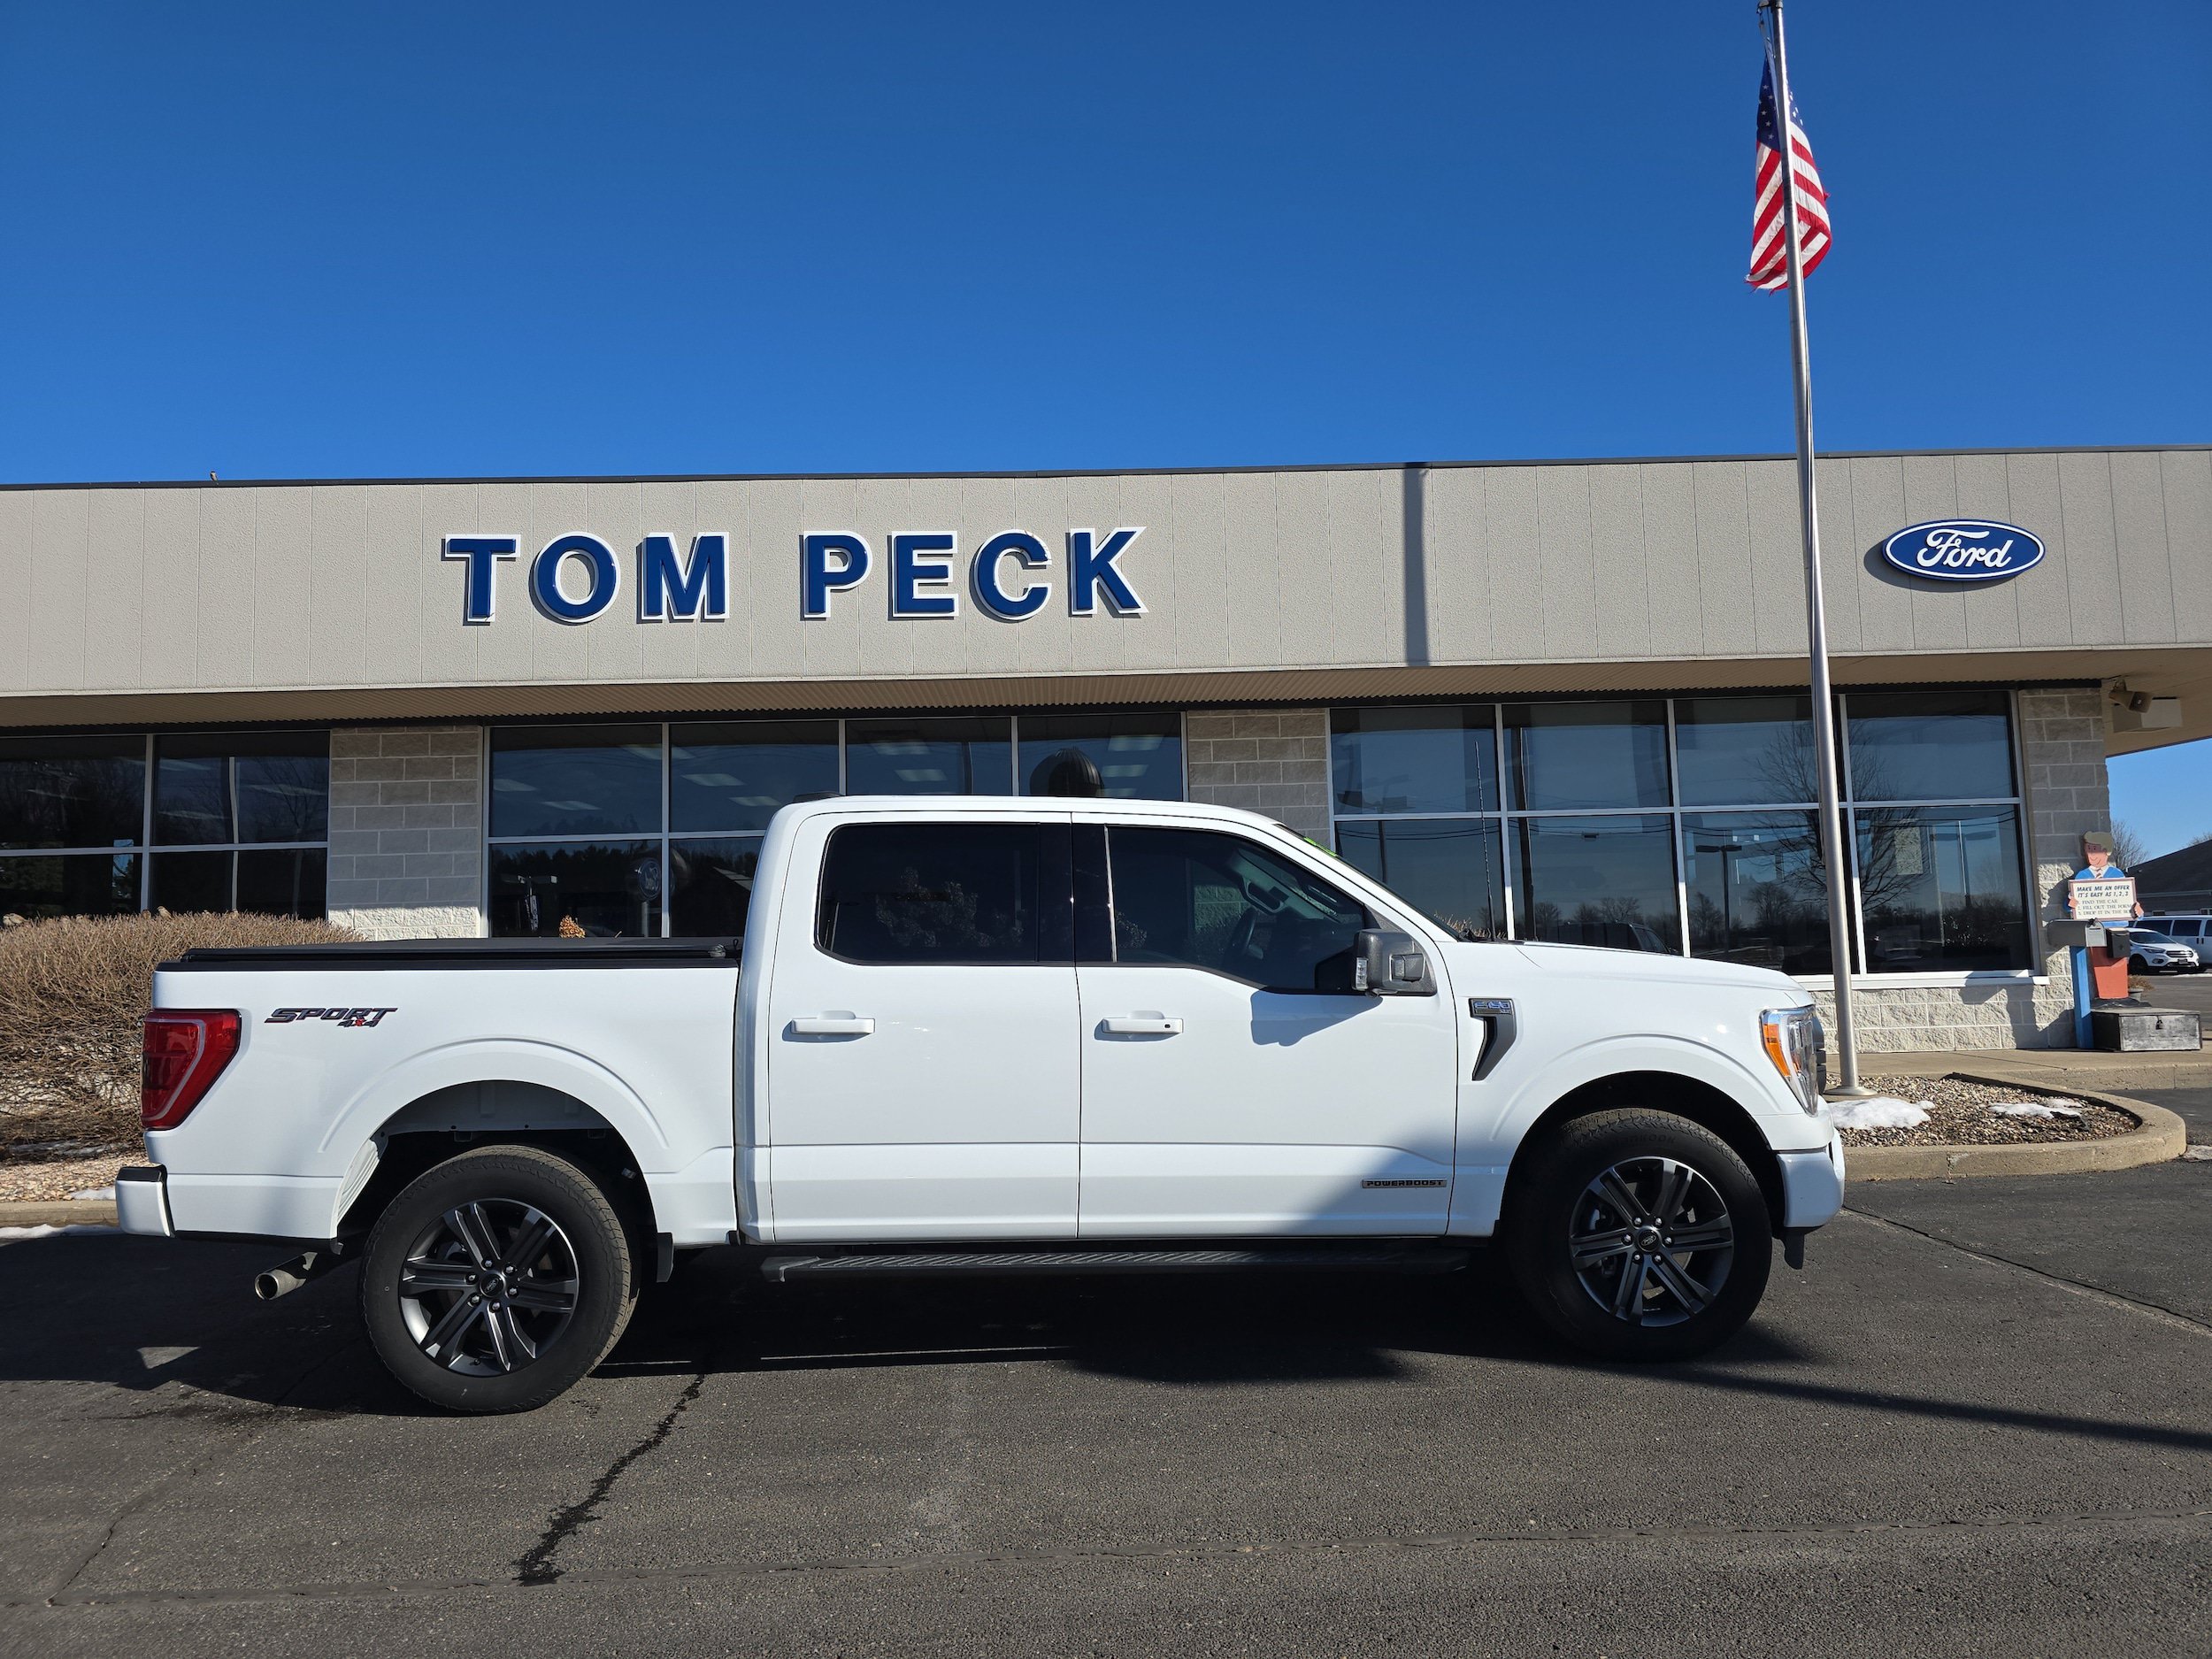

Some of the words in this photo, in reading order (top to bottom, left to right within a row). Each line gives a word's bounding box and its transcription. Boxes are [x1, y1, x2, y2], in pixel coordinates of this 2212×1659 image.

[1916, 528, 2014, 567] Ford
[443, 531, 729, 624] TOM
[802, 526, 1148, 622] PECK
[264, 1008, 398, 1024] SPORT
